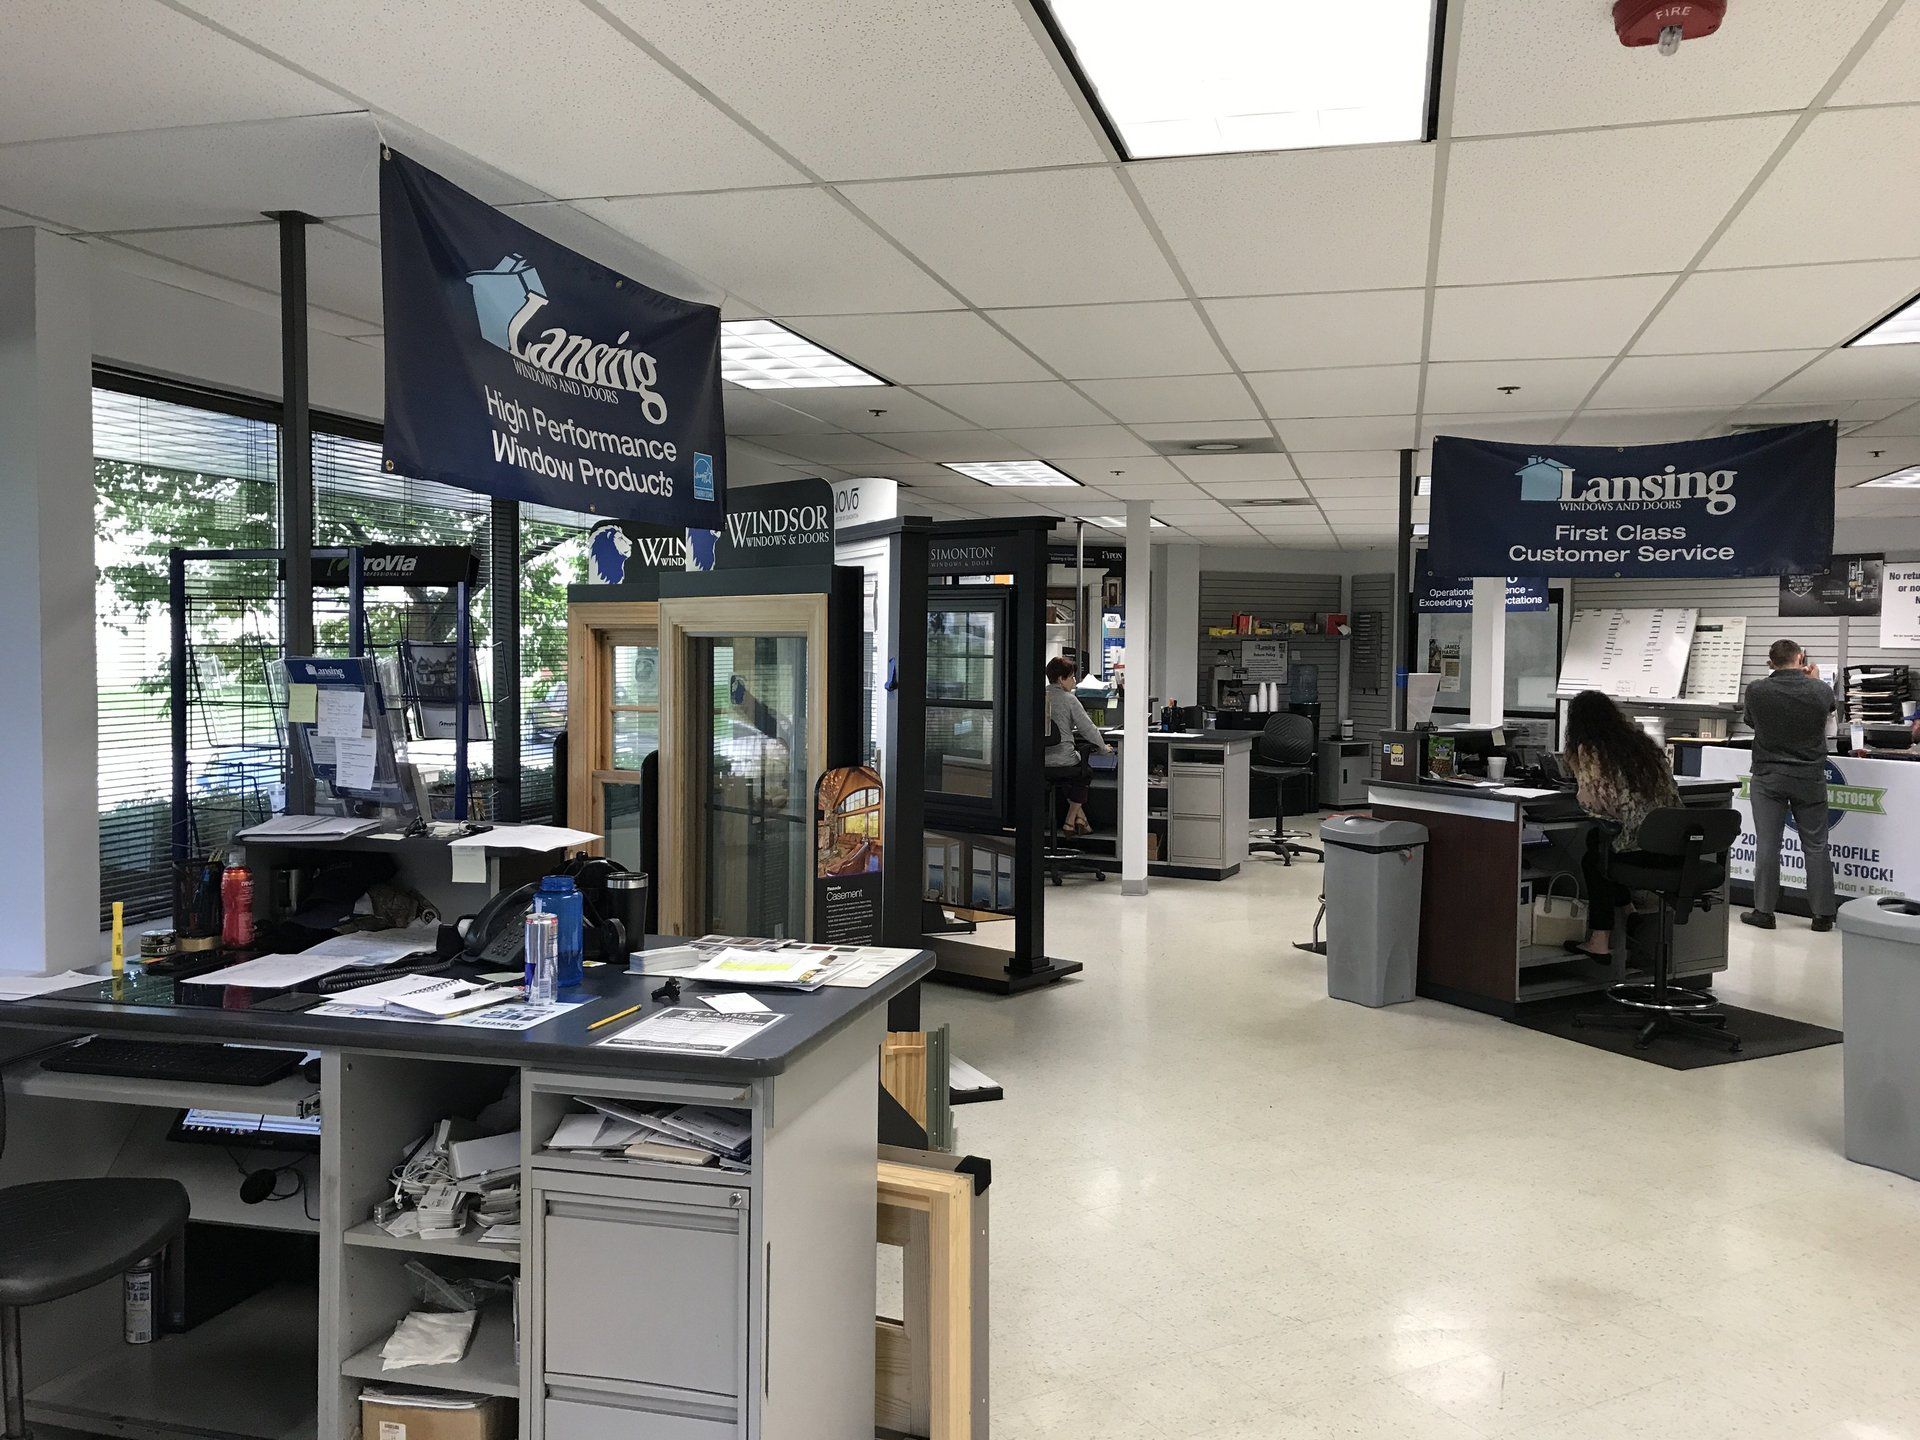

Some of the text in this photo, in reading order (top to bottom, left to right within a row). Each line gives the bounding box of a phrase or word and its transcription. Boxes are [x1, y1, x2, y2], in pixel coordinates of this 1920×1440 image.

[1655, 6, 1692, 20] FIRE
[507, 291, 667, 425] Lansing
[512, 358, 619, 405] WINDOWS AND DOORS
[484, 384, 677, 462] High Performance
[491, 430, 674, 498] Window Products
[1557, 465, 1738, 516] Lansing
[1560, 500, 1682, 511] WINDOWS AND DOORS
[726, 505, 830, 549] WINDSOR
[1555, 524, 1687, 541] First Class
[745, 531, 830, 548] WINDOWS & DOORS
[930, 546, 994, 561] SIMONTON
[1508, 544, 1735, 563] Customer Service
[363, 554, 417, 571] roVia
[1889, 572, 1901, 581] No
[1419, 595, 1543, 609] Exceeding yo ctations
[1429, 588, 1473, 599] Operationa
[1836, 791, 1875, 807] STOCK
[1843, 863, 1894, 882] STOCK!
[826, 889, 863, 902] Casement
